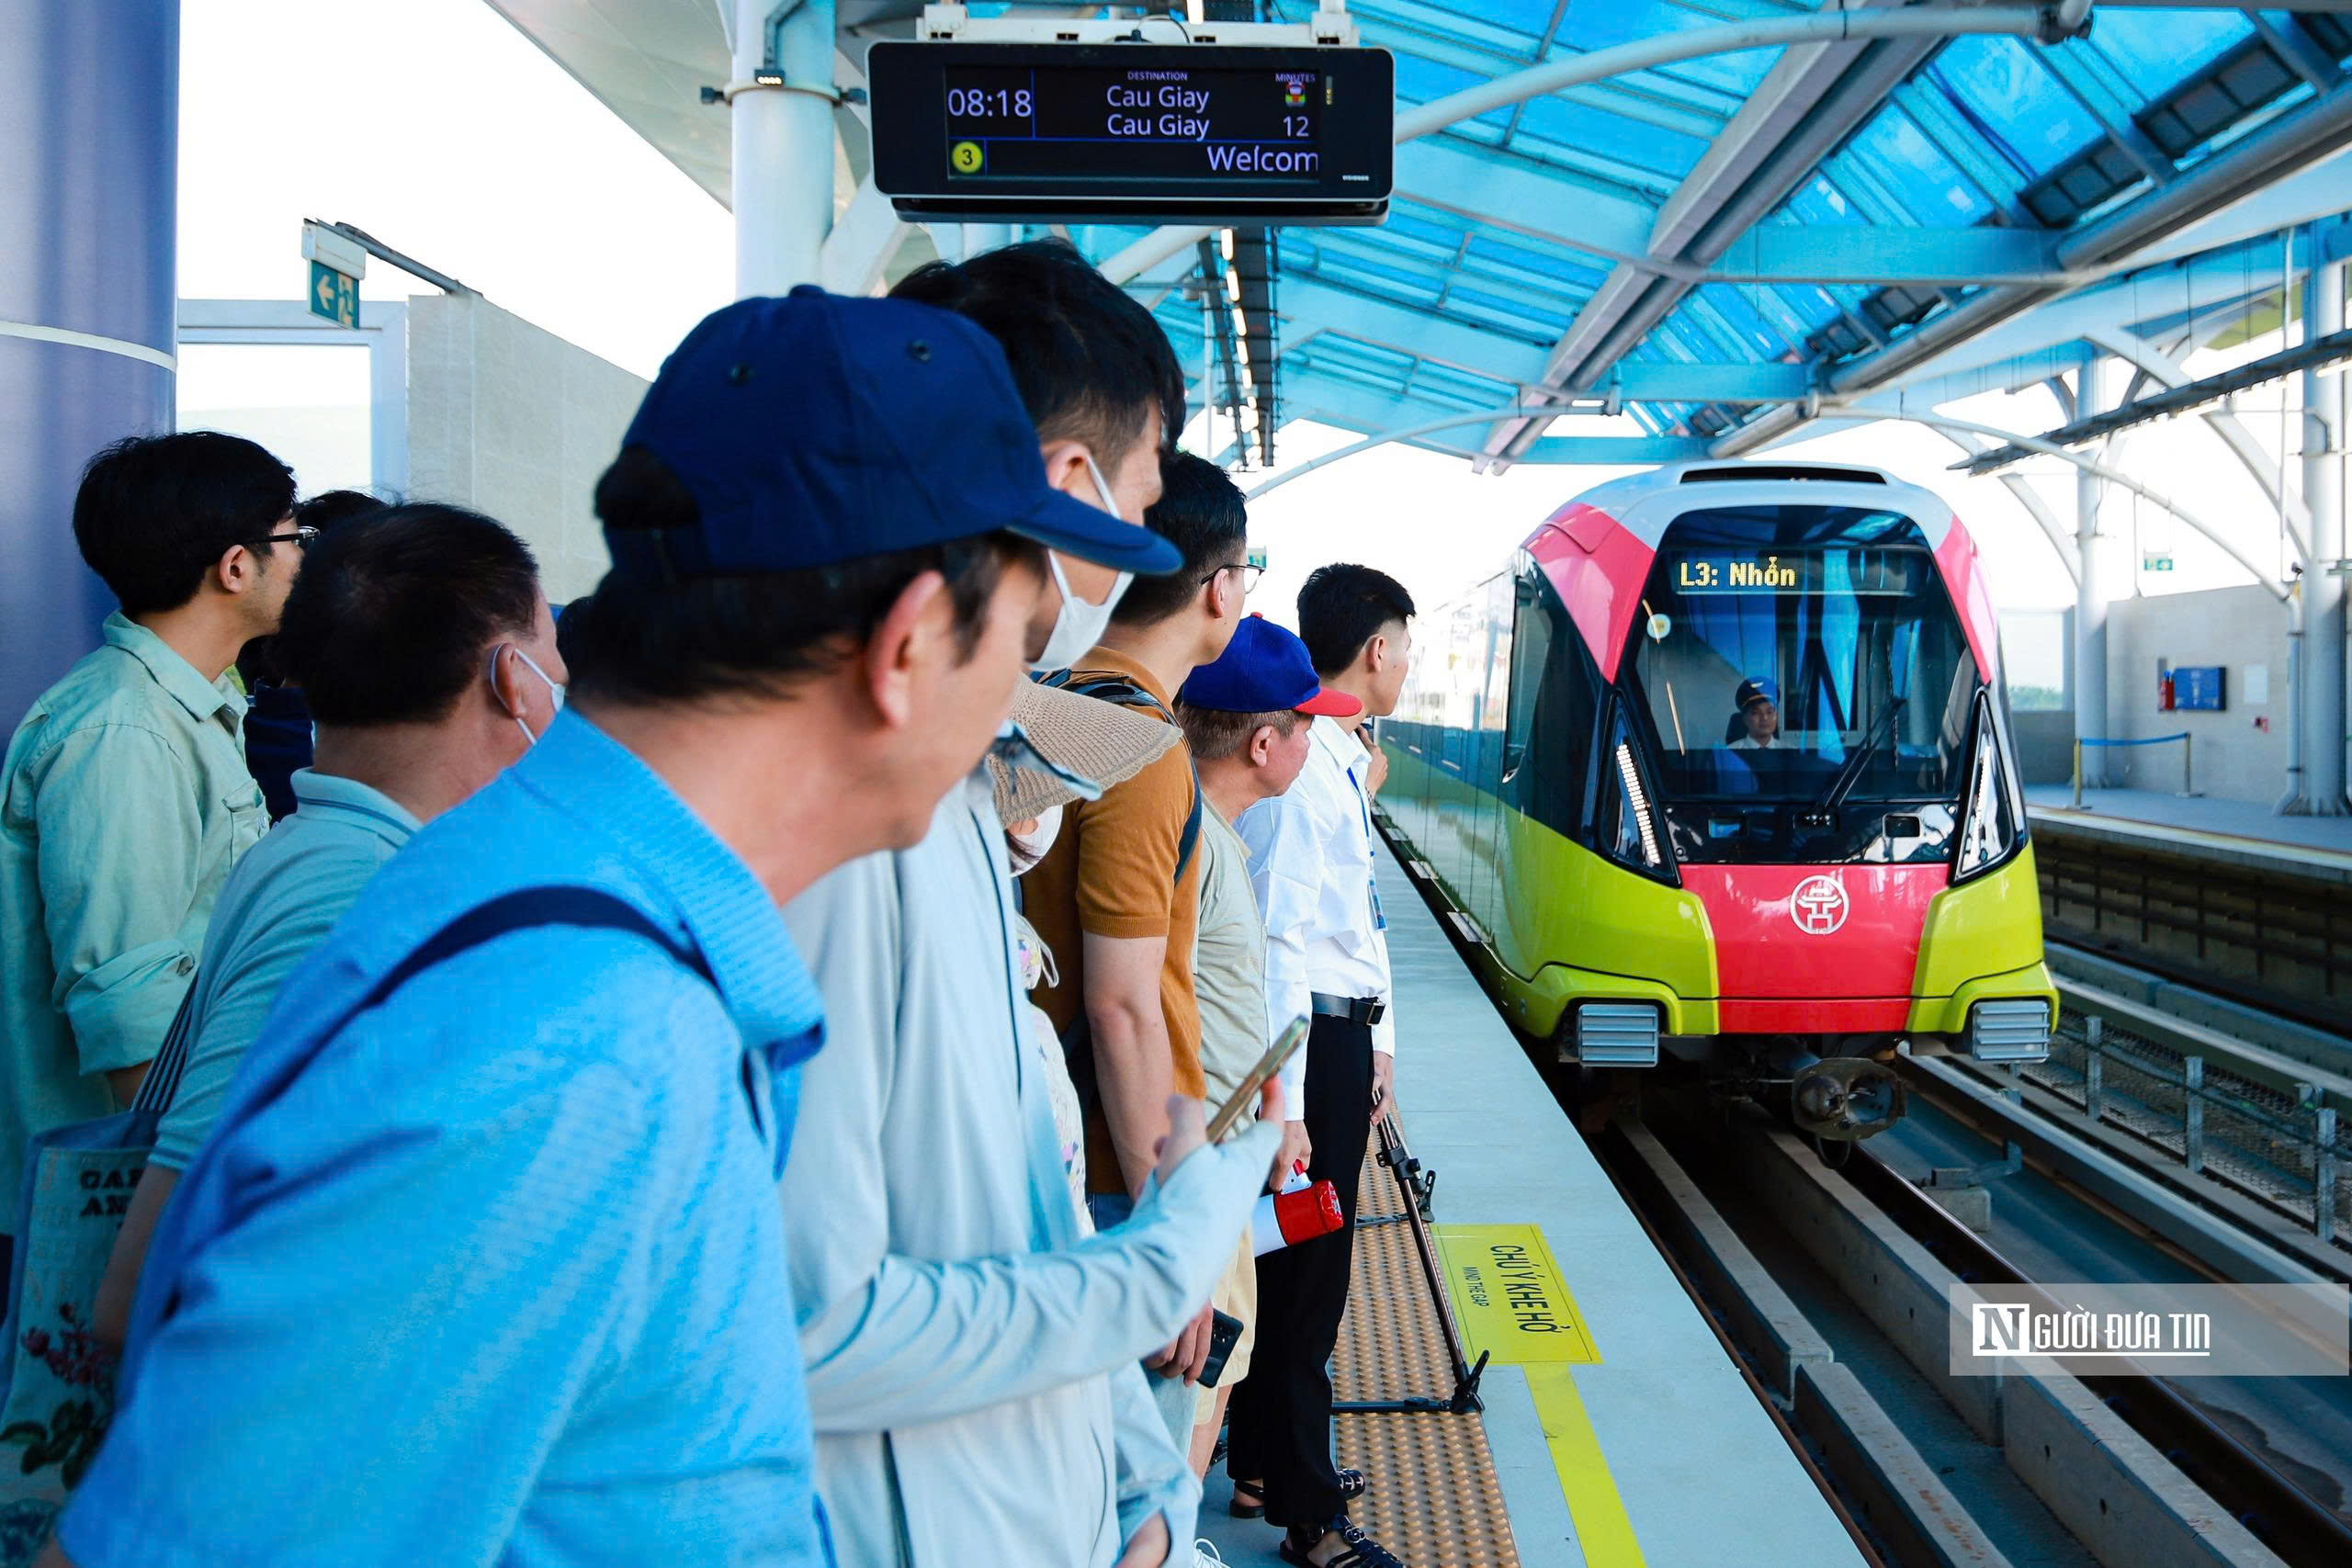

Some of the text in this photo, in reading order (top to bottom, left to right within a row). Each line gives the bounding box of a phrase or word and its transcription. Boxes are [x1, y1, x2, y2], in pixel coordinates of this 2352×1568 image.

[1127, 71, 1188, 81] DESTINATION
[1275, 73, 1316, 83] MINUTES
[948, 88, 1032, 117] 08:18
[1106, 85, 1210, 114] Cau Giay
[1107, 114, 1210, 141] Cau Giay
[1283, 116, 1309, 137] 12
[962, 149, 974, 166] 3
[1206, 145, 1318, 172] Welcom
[1680, 556, 1795, 587] L3: Nhổn
[1463, 1267, 1489, 1307] MIND THE GAP
[1490, 1245, 1571, 1334] CHÚ Ý KHE HỞ
